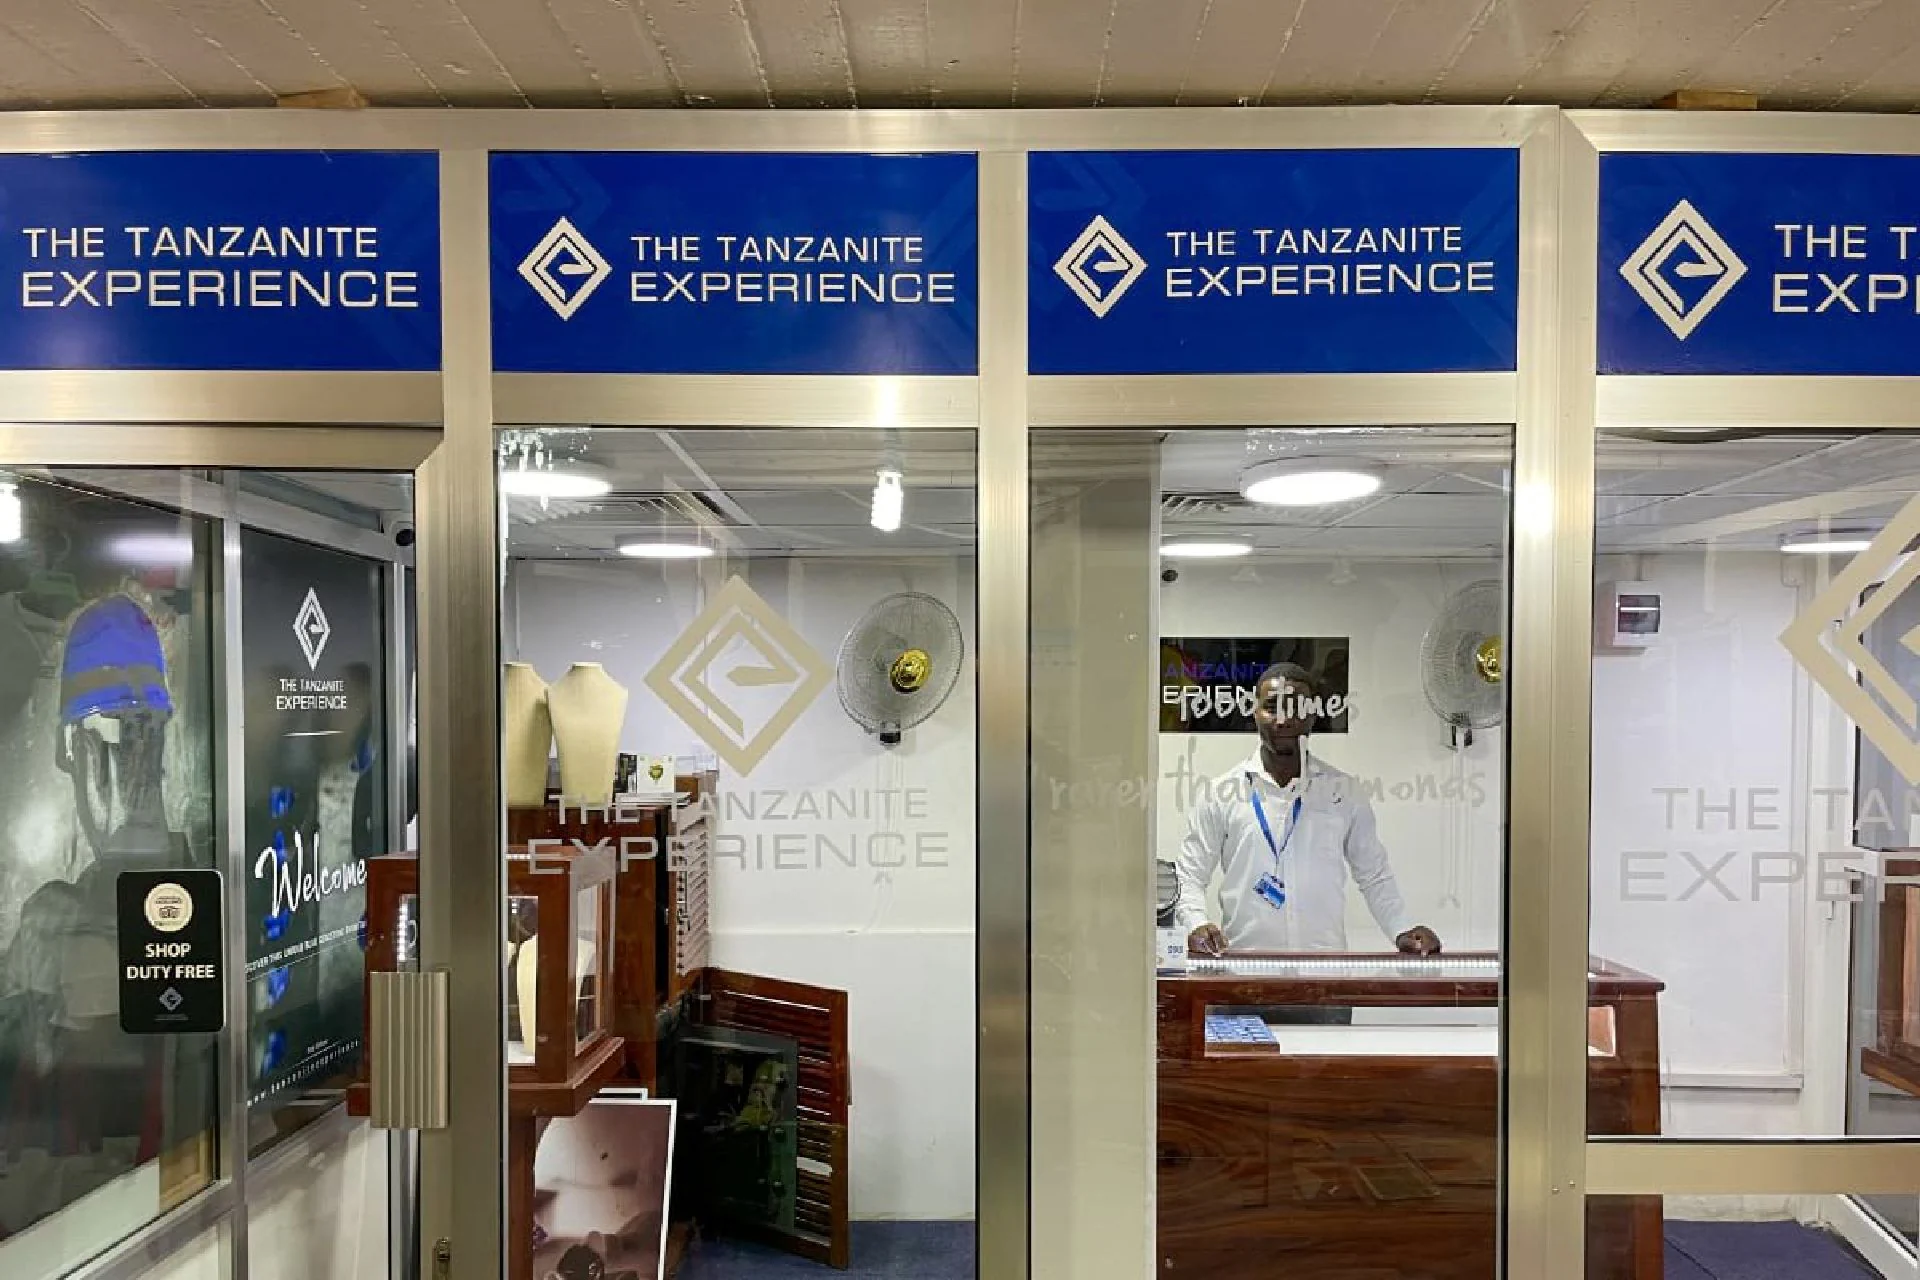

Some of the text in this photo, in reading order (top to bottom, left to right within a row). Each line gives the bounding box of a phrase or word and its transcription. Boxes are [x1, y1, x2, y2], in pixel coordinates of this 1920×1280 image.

[23, 226, 378, 258] THE TANZANITE
[630, 236, 923, 263] THE TANZANITE
[1166, 226, 1462, 256] THE TANZANITE
[1774, 224, 1867, 259] THE
[22, 270, 419, 308] EXPERIENCE
[630, 272, 956, 303] EXPERIENCE
[1166, 261, 1494, 297] EXPERIENCE
[1772, 273, 1920, 315] EXP
[279, 678, 297, 692] THE
[276, 695, 347, 710] EXPERIENCE
[548, 788, 928, 825] THE TANZANITE
[1652, 787, 1780, 830] THE
[527, 831, 949, 876] EXPERIENCE
[254, 831, 368, 918] Welcome
[145, 943, 191, 958] SHOP
[126, 965, 216, 979] DUTY FREE
